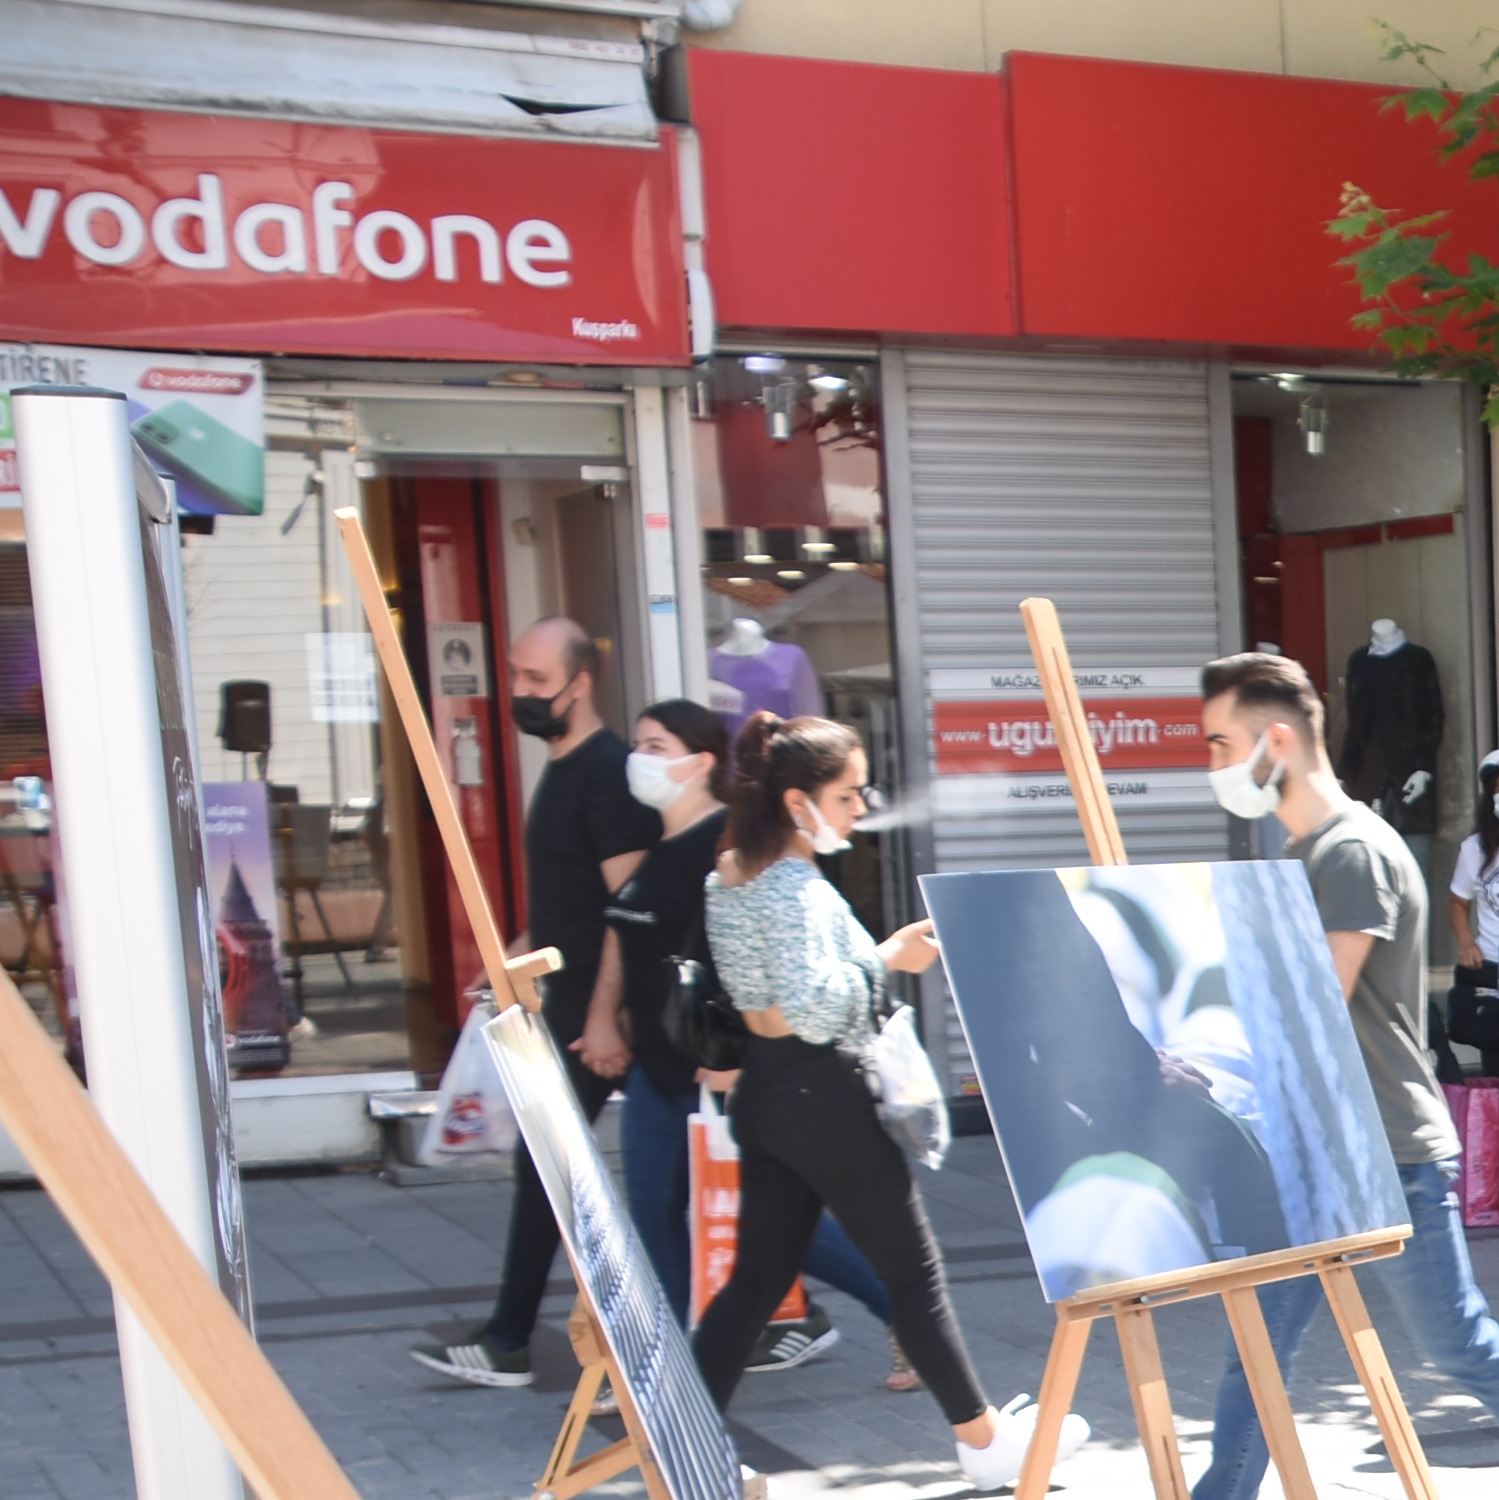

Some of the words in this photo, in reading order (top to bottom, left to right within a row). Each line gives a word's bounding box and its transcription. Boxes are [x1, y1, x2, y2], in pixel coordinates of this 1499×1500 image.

[0, 173, 572, 288] vodafone
[168, 373, 242, 390] vodafone
[1107, 782, 1147, 795] EVAM
